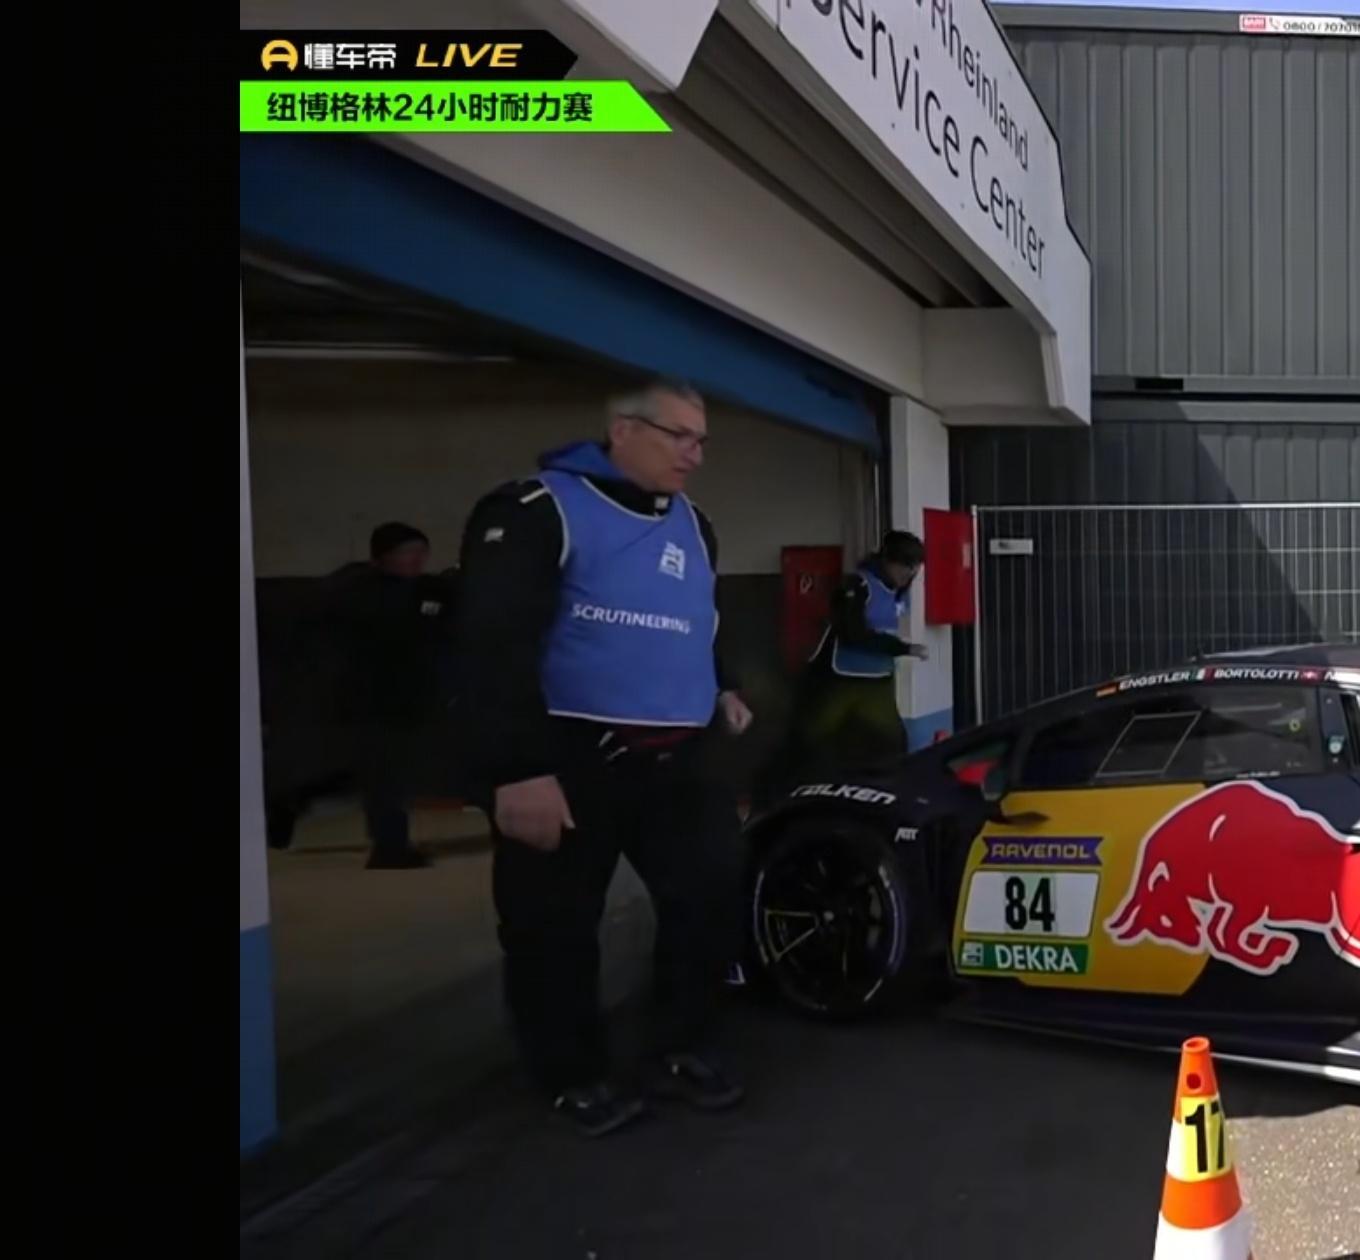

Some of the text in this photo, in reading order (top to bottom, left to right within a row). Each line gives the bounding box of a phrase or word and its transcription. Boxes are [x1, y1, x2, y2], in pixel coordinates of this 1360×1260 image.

[812, 0, 1045, 279] ervice Center
[1118, 668, 1299, 690] ENGSTLER BORTOLOTTI
[990, 842, 1091, 859] RAVENOL
[1004, 875, 1055, 932] 84
[994, 943, 1079, 973] DEKRA
[1184, 1101, 1225, 1174] 17
